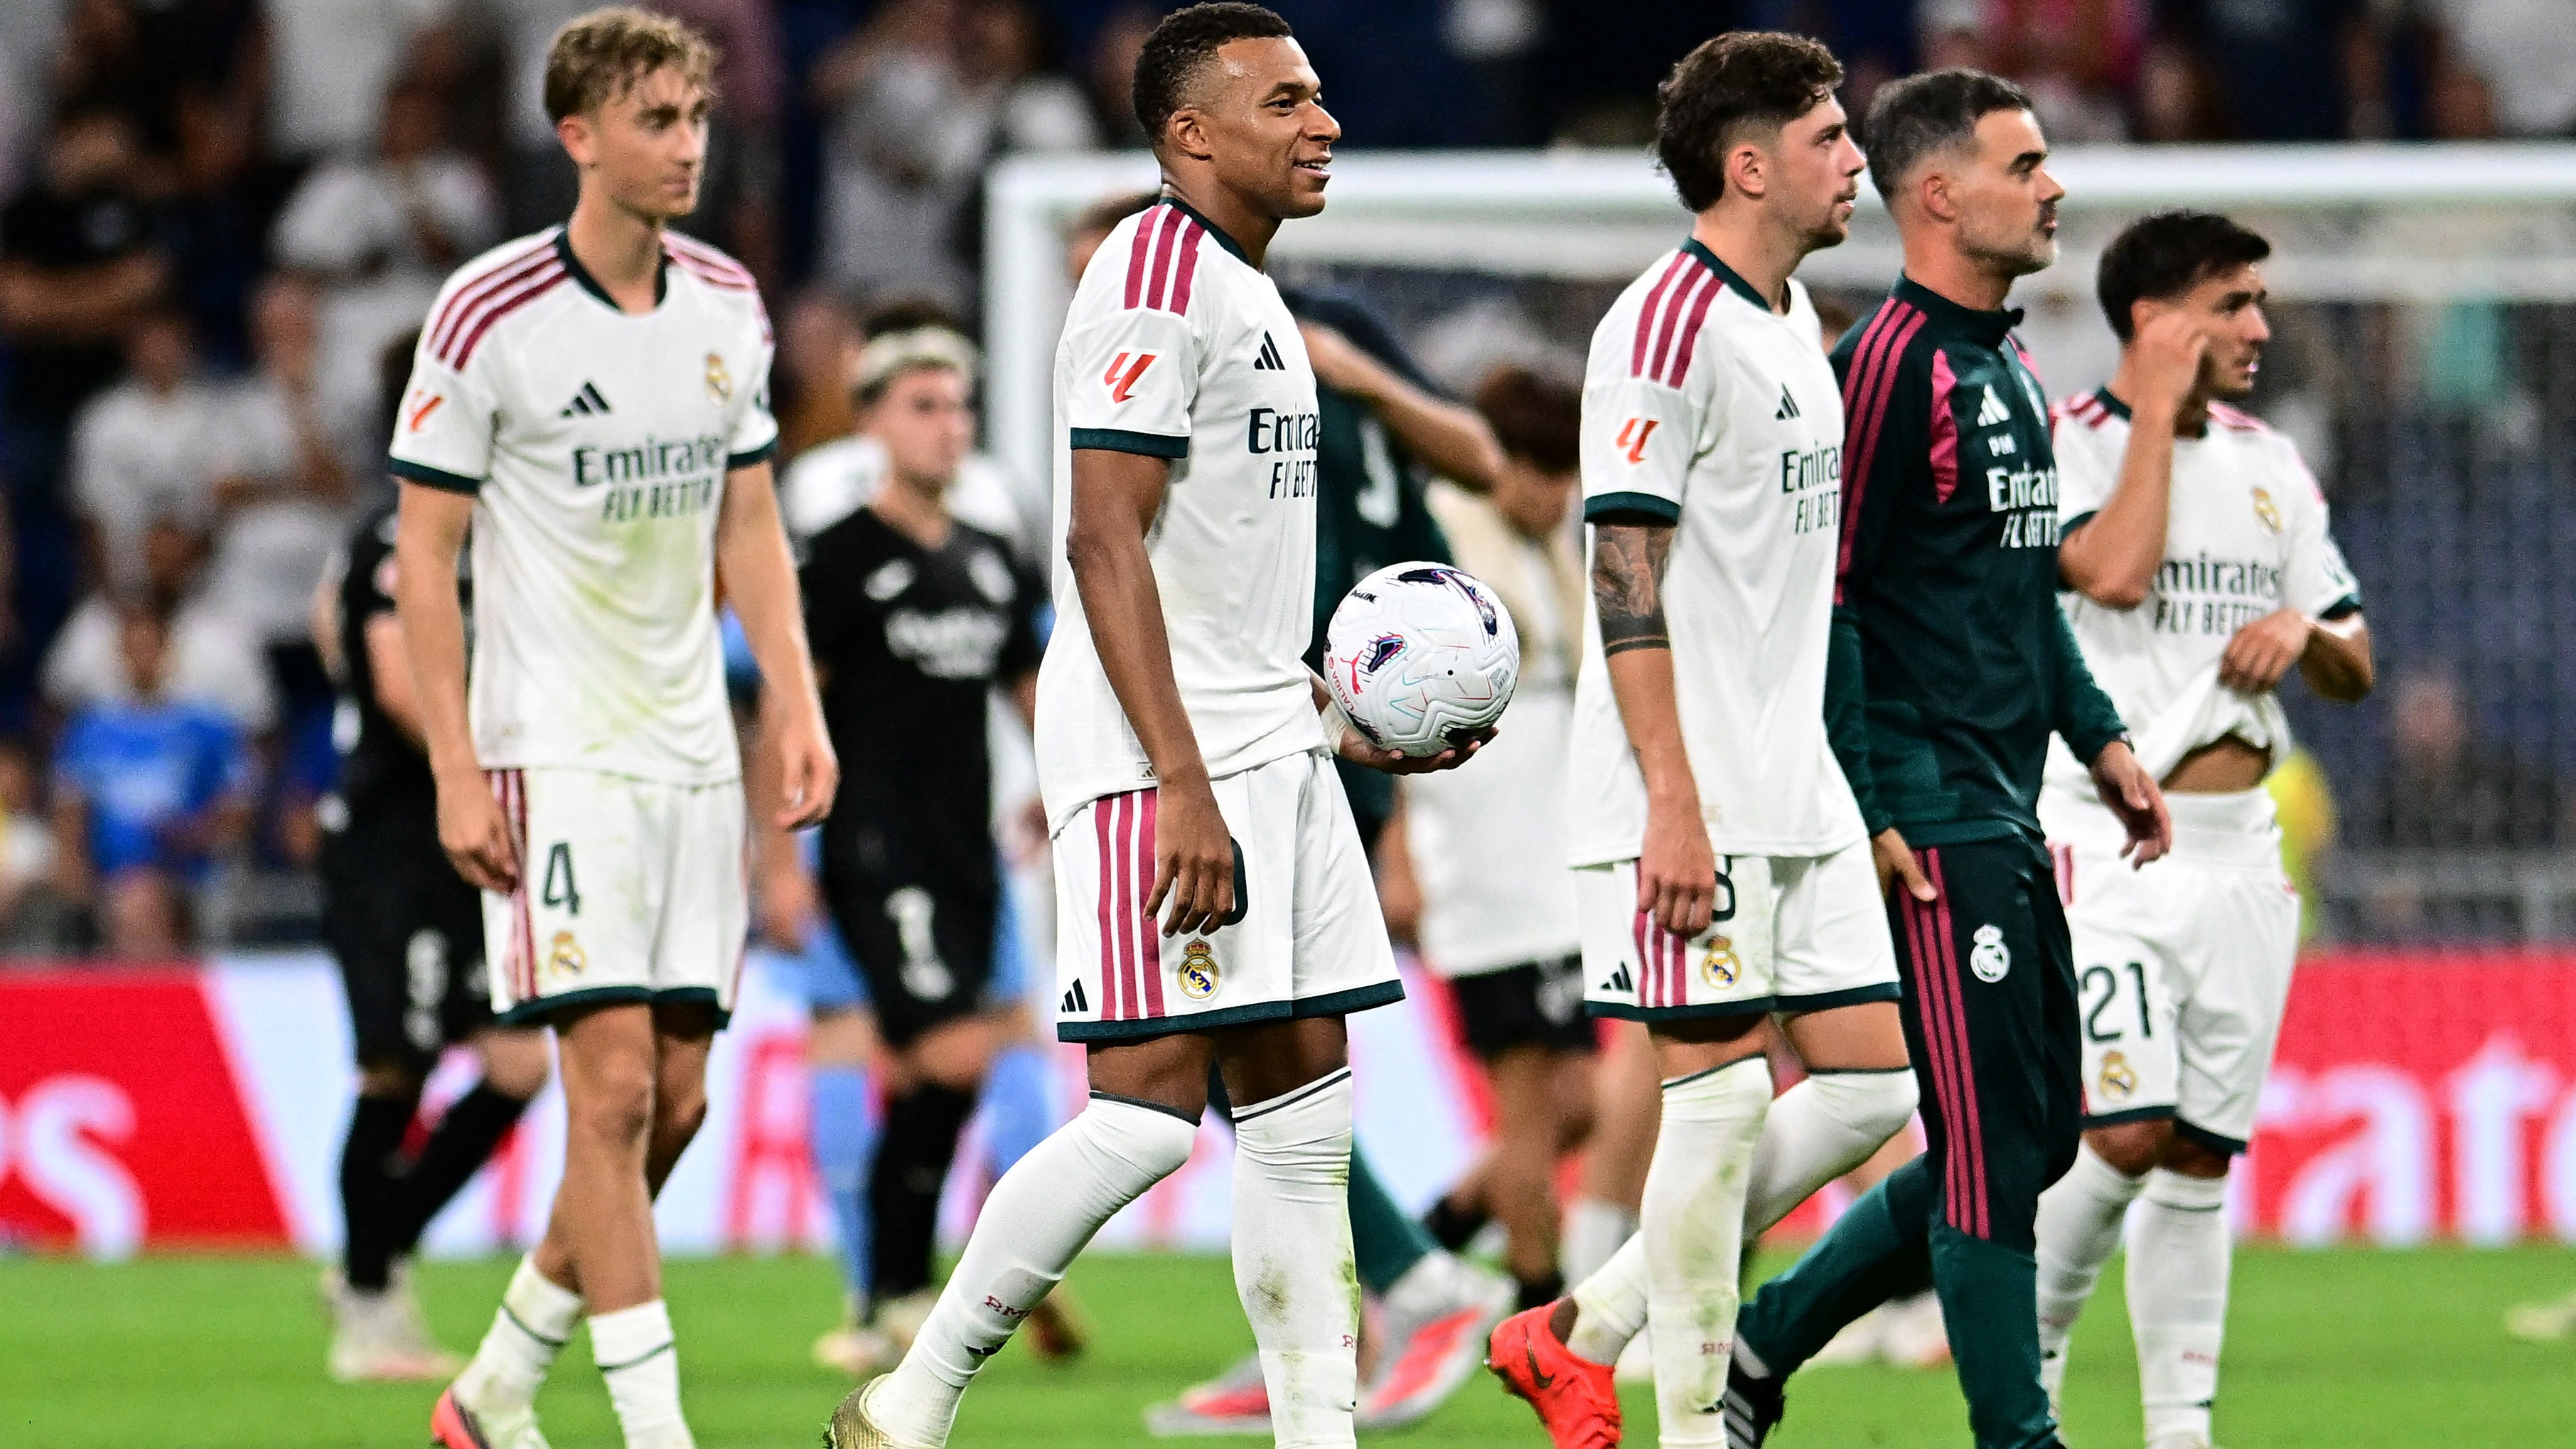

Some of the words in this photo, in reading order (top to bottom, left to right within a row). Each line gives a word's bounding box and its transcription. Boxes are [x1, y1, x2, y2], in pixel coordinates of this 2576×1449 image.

[1248, 402, 1320, 454] Emira
[2157, 549, 2281, 599] mirates
[1331, 670, 1355, 712] LALIGA
[542, 842, 580, 916] 4
[2081, 961, 2152, 1043] 21
[1342, 1334, 1357, 1350] R
